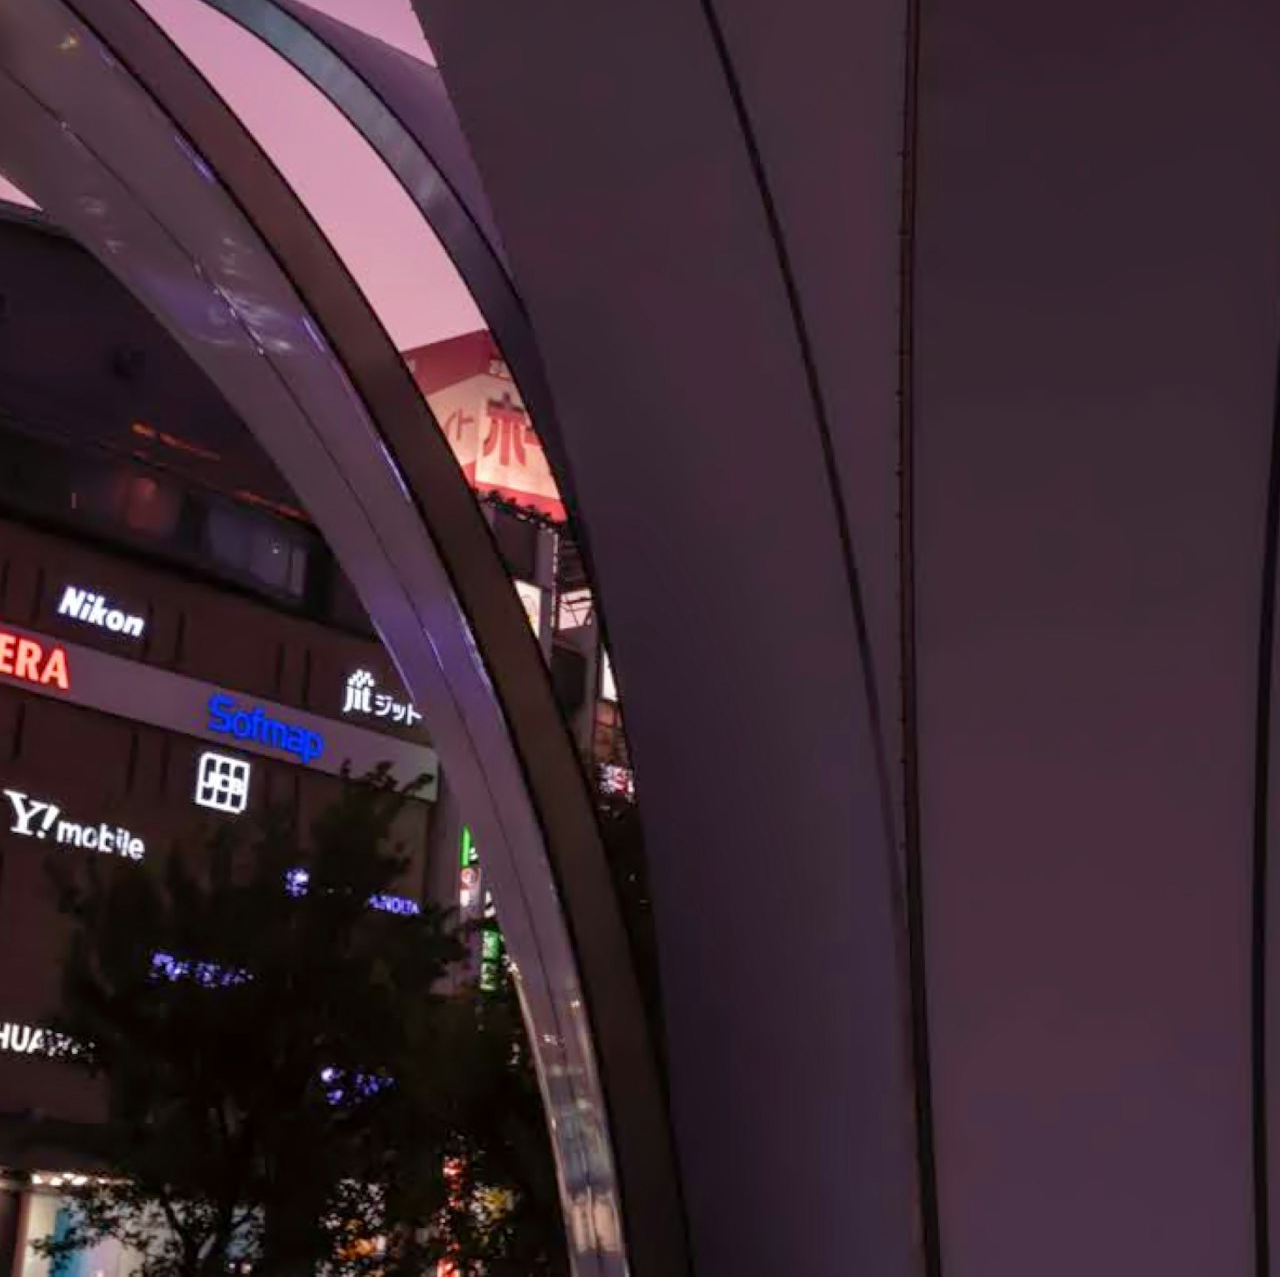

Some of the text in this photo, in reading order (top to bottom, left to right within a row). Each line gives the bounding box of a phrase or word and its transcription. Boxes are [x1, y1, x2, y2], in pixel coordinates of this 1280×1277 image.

[58, 586, 145, 637] Nikon
[206, 692, 325, 764] Sofmap
[343, 680, 423, 726] jit ジット
